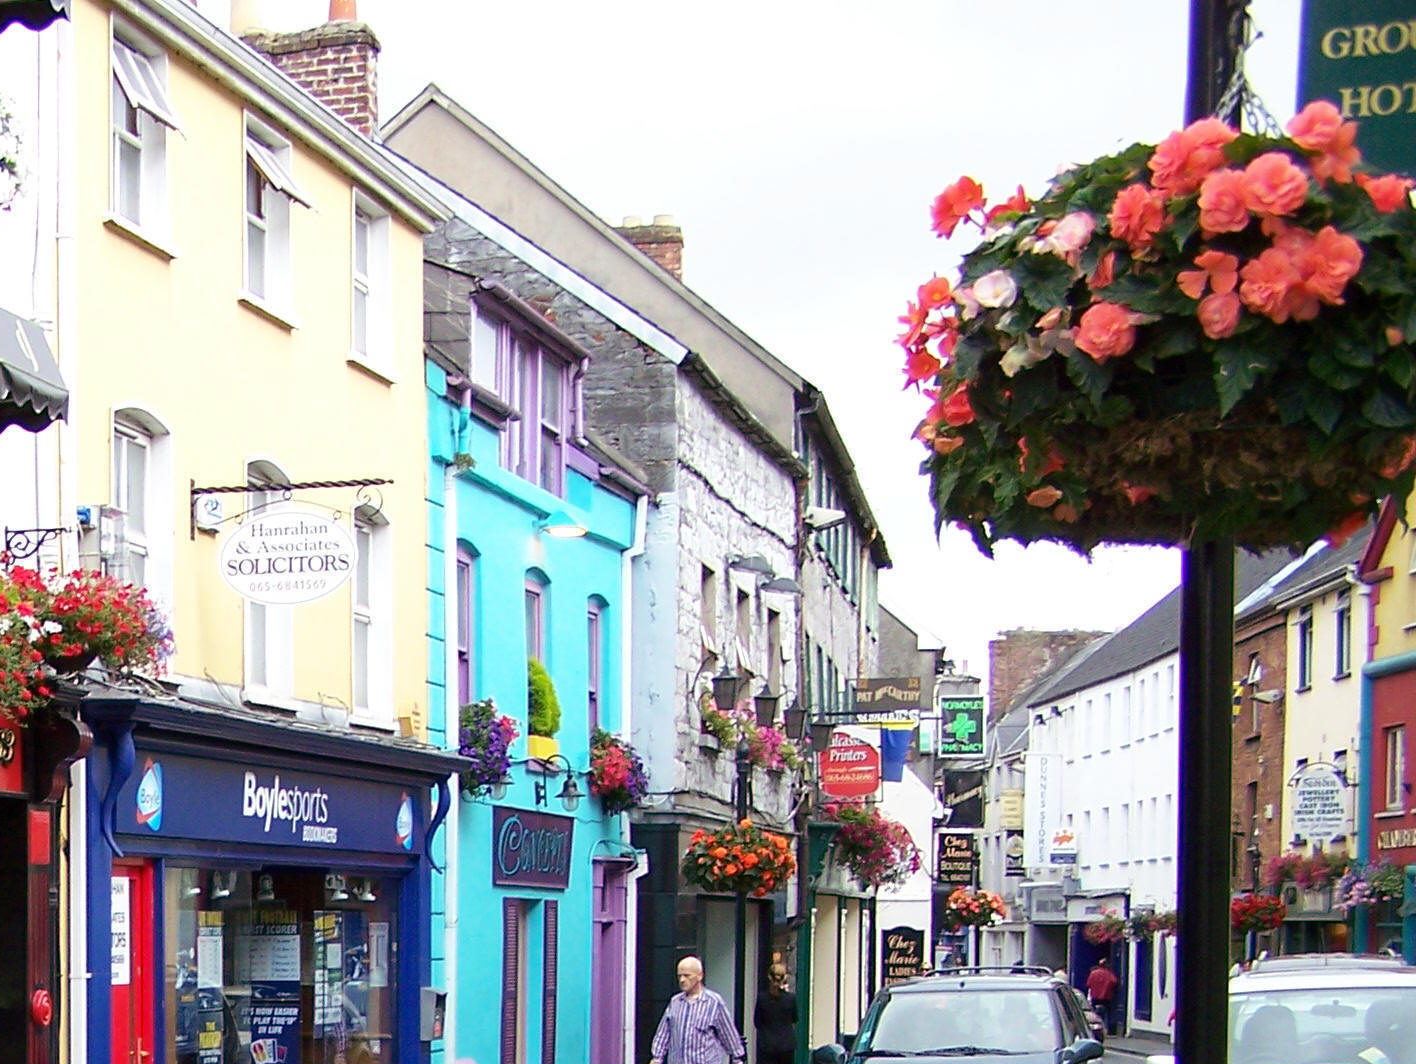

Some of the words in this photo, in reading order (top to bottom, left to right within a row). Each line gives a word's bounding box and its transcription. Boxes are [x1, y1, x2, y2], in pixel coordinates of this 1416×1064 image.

[251, 521, 328, 537] Hanrahan
[236, 541, 250, 554] &
[257, 538, 340, 553] Associates
[227, 553, 350, 577] SOLICITORS
[242, 771, 329, 833] Boylesports
[887, 934, 917, 955] Chez
